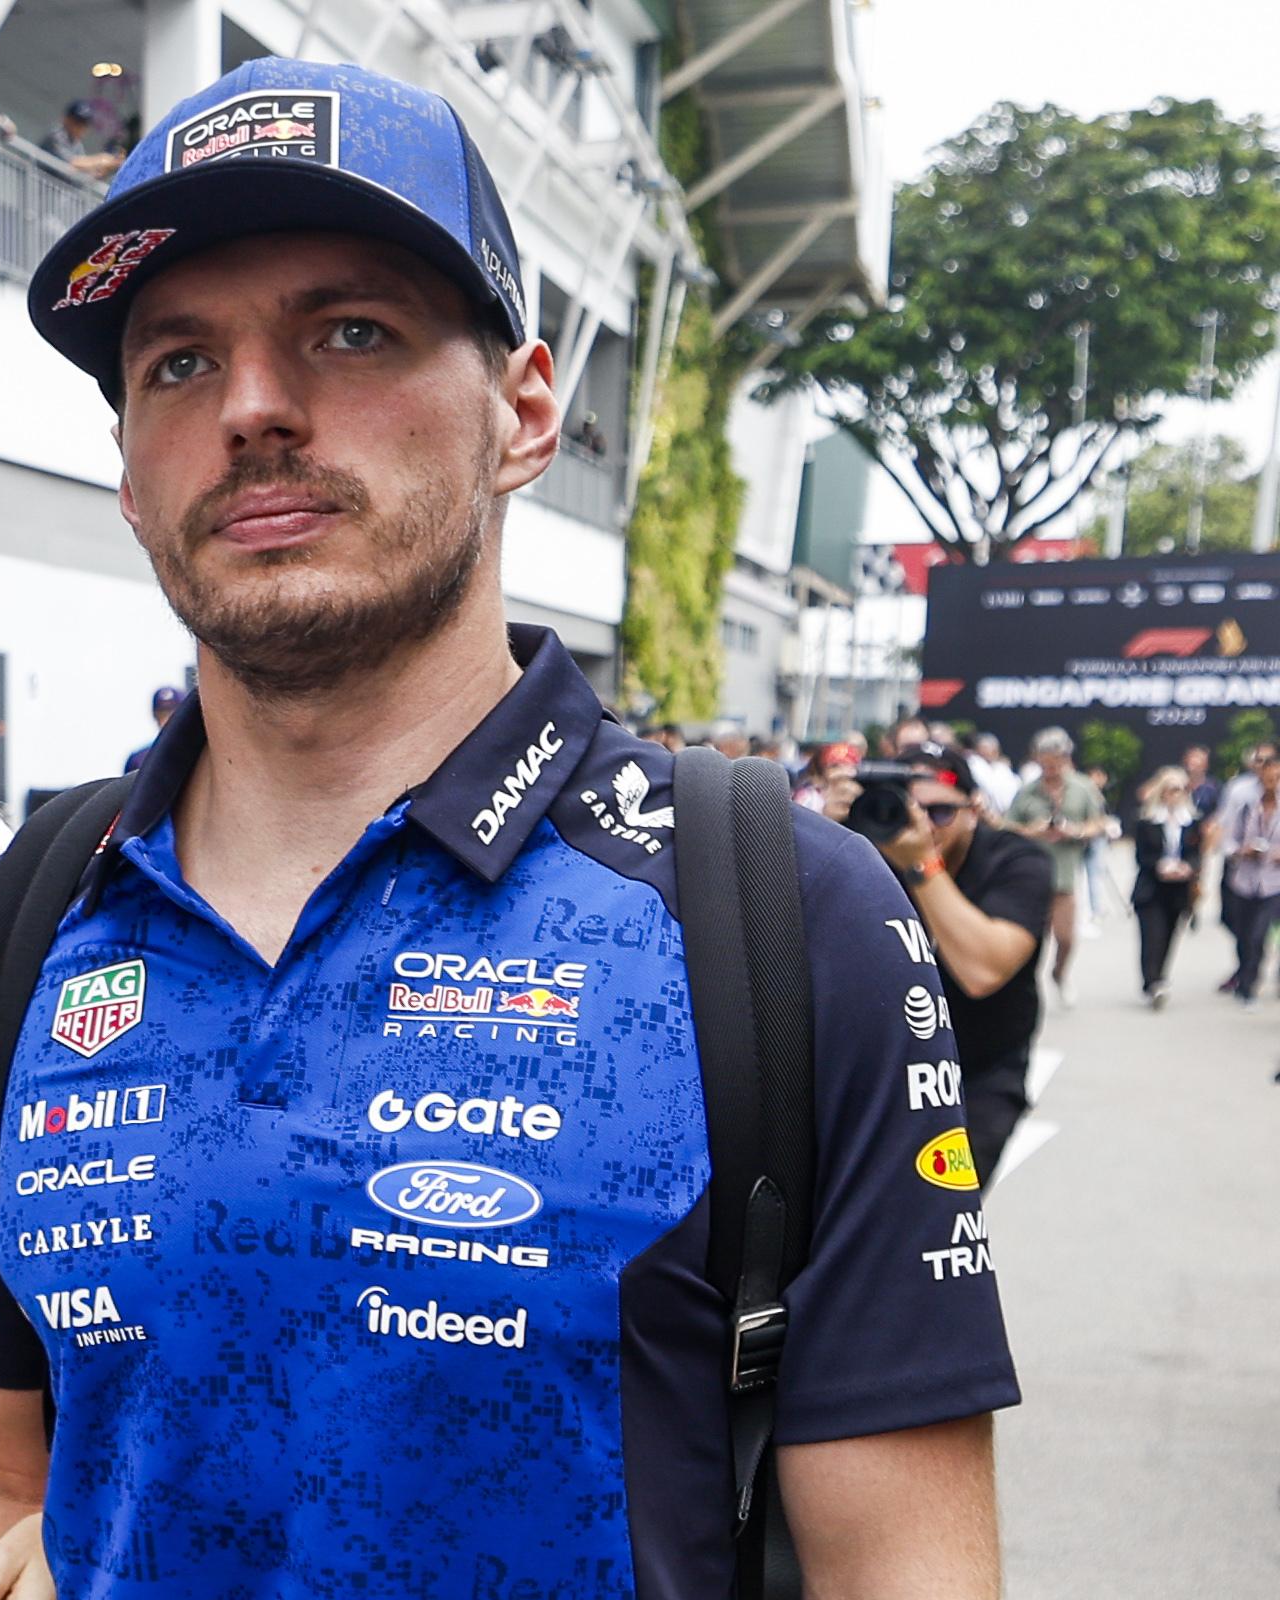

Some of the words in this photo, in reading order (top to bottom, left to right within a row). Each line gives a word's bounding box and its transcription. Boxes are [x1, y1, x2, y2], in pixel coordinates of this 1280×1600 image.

[183, 102, 316, 146] ORACLE
[977, 675, 1174, 708] SINGAPORE
[471, 721, 563, 846] DAMAC
[580, 790, 663, 855] CASTORE
[67, 966, 137, 1007] TAG
[393, 951, 588, 989] ORACLE
[57, 1000, 137, 1055] HEUER
[383, 1022, 578, 1047] RACING
[19, 1090, 118, 1142] Mobil
[16, 1154, 157, 1197] ORACLE
[397, 1168, 507, 1218] Ford
[19, 1214, 153, 1257] CARLYLE
[351, 1227, 549, 1269] RACING
[35, 1286, 121, 1331] VISA
[358, 1287, 528, 1350] indeed
[76, 1325, 147, 1348] INFINITE
